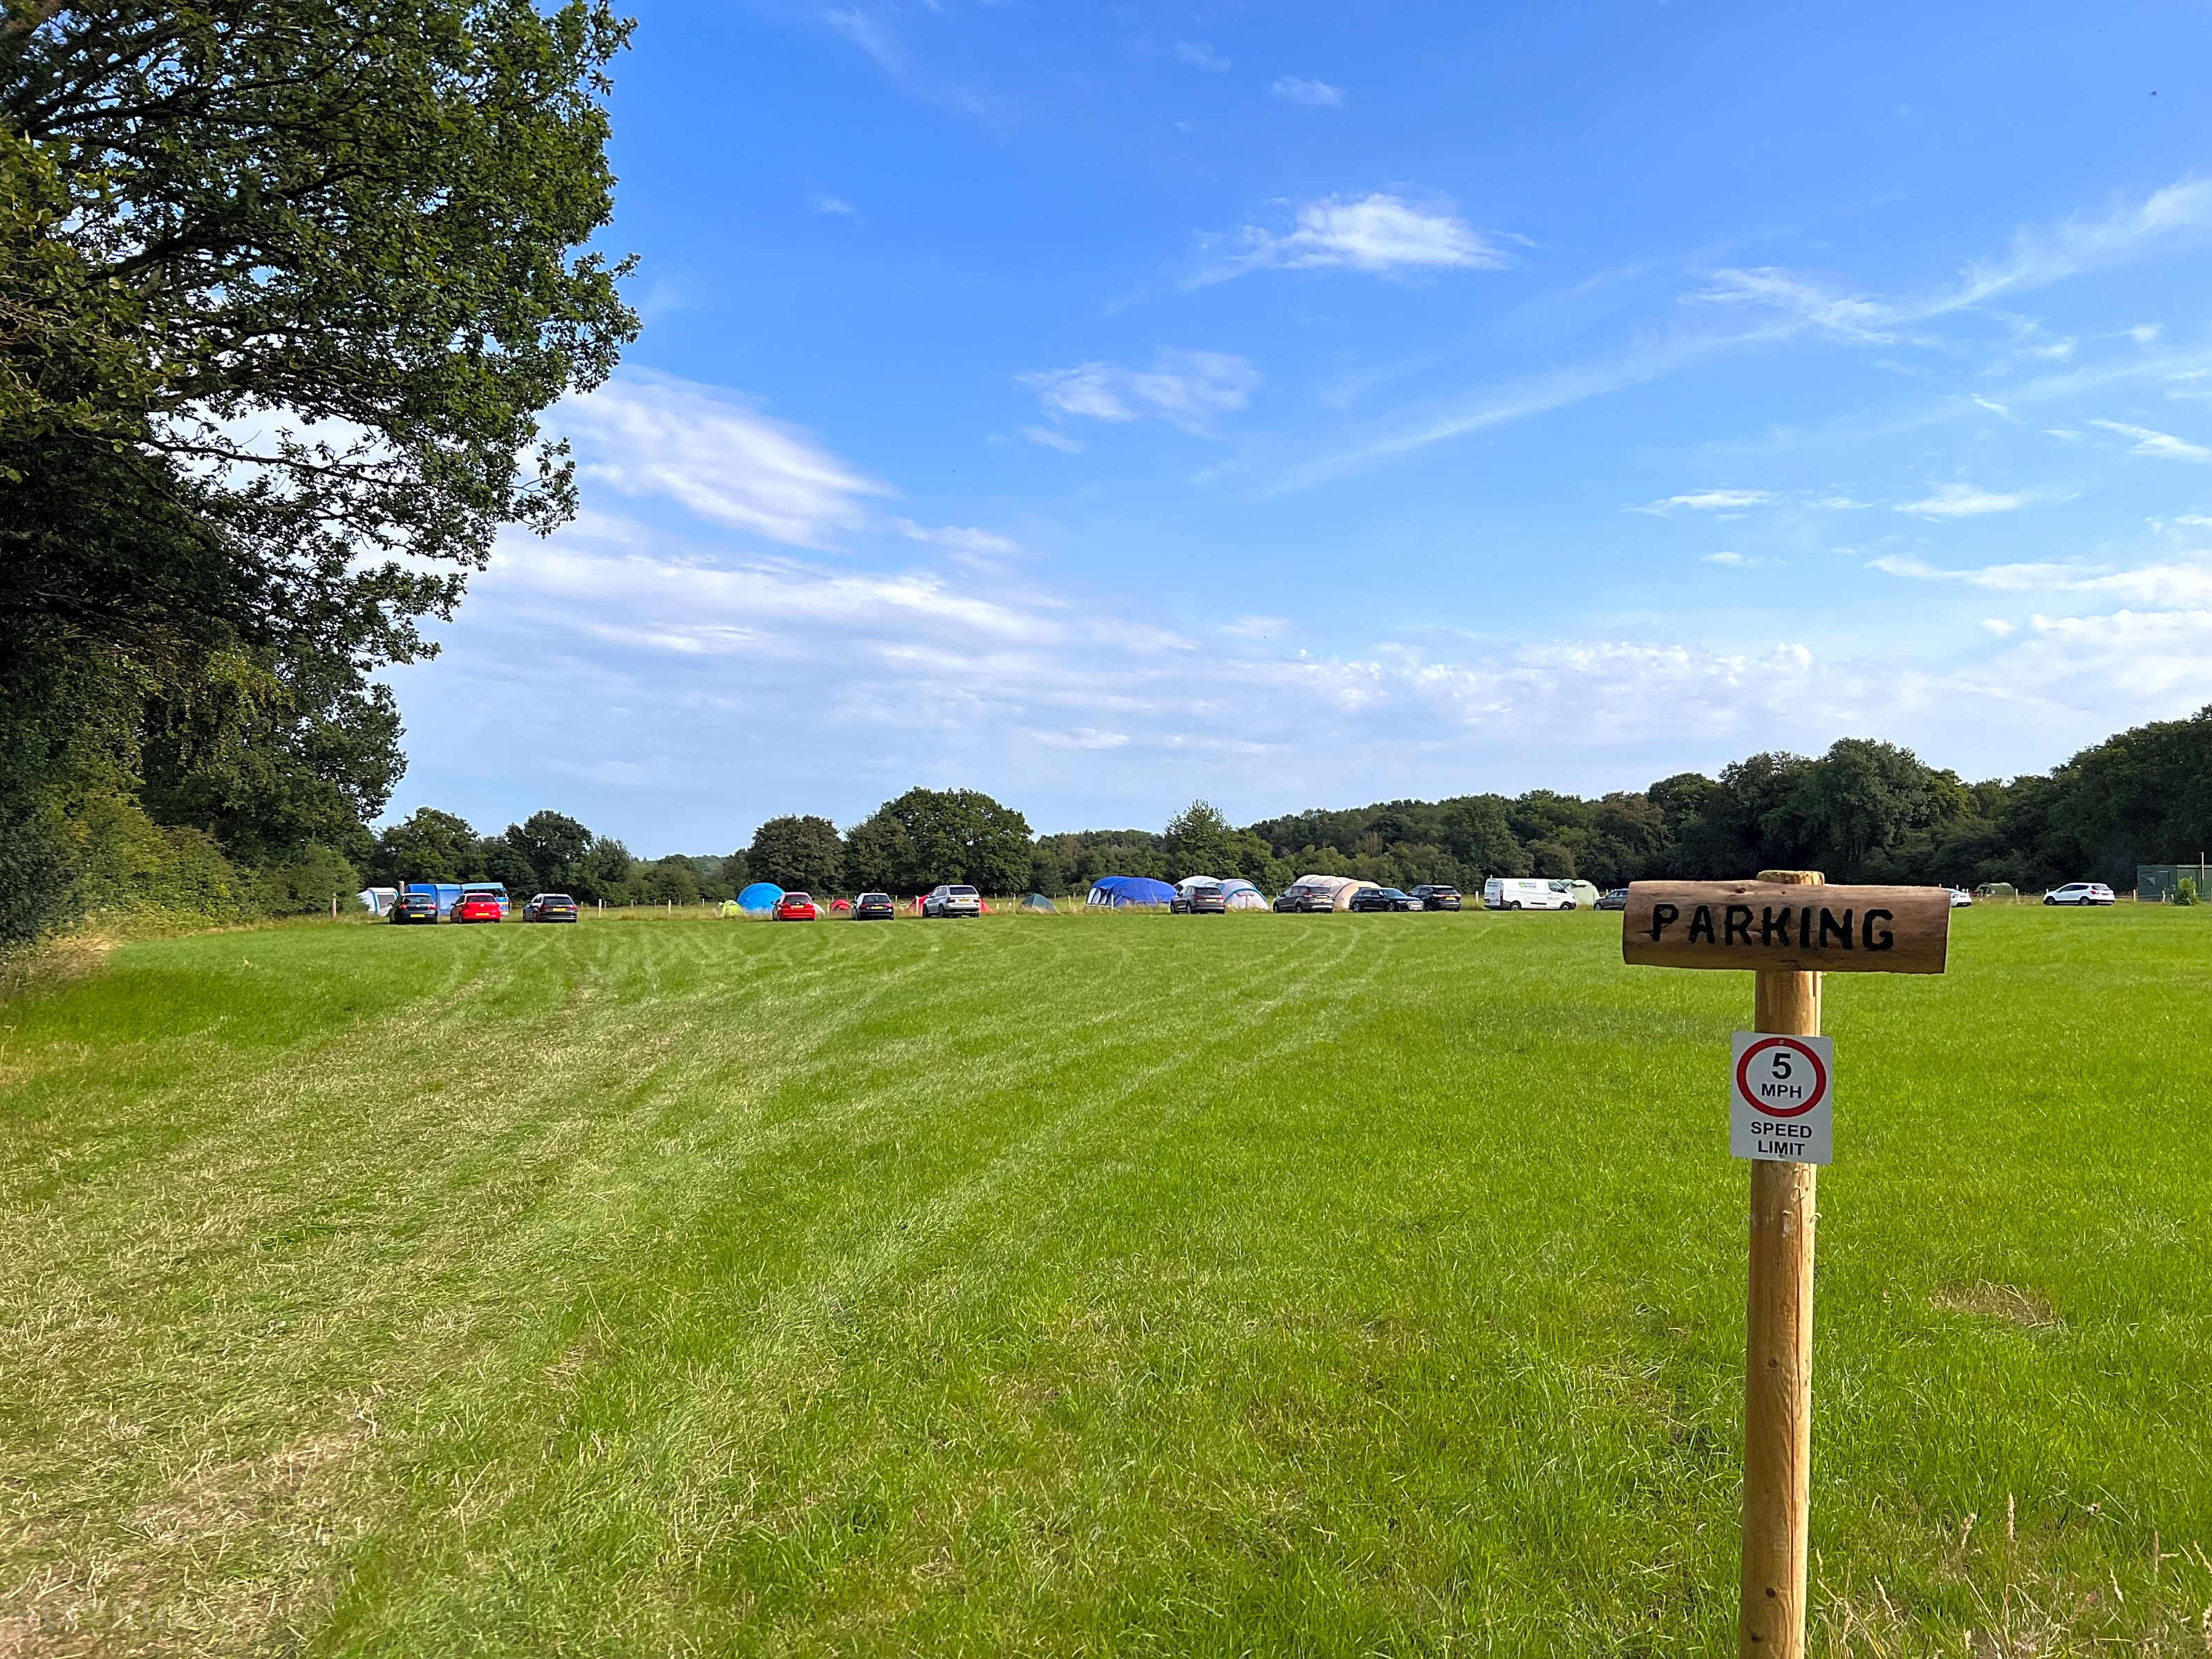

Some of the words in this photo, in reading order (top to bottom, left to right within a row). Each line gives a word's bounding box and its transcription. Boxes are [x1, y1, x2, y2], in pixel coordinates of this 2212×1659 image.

[1652, 904, 1893, 951] PARKING
[1771, 1053, 1792, 1079] 5
[1761, 1083, 1802, 1099] MPH
[1750, 1121, 1812, 1138] SPEED
[1758, 1139, 1806, 1156] LIMIT
